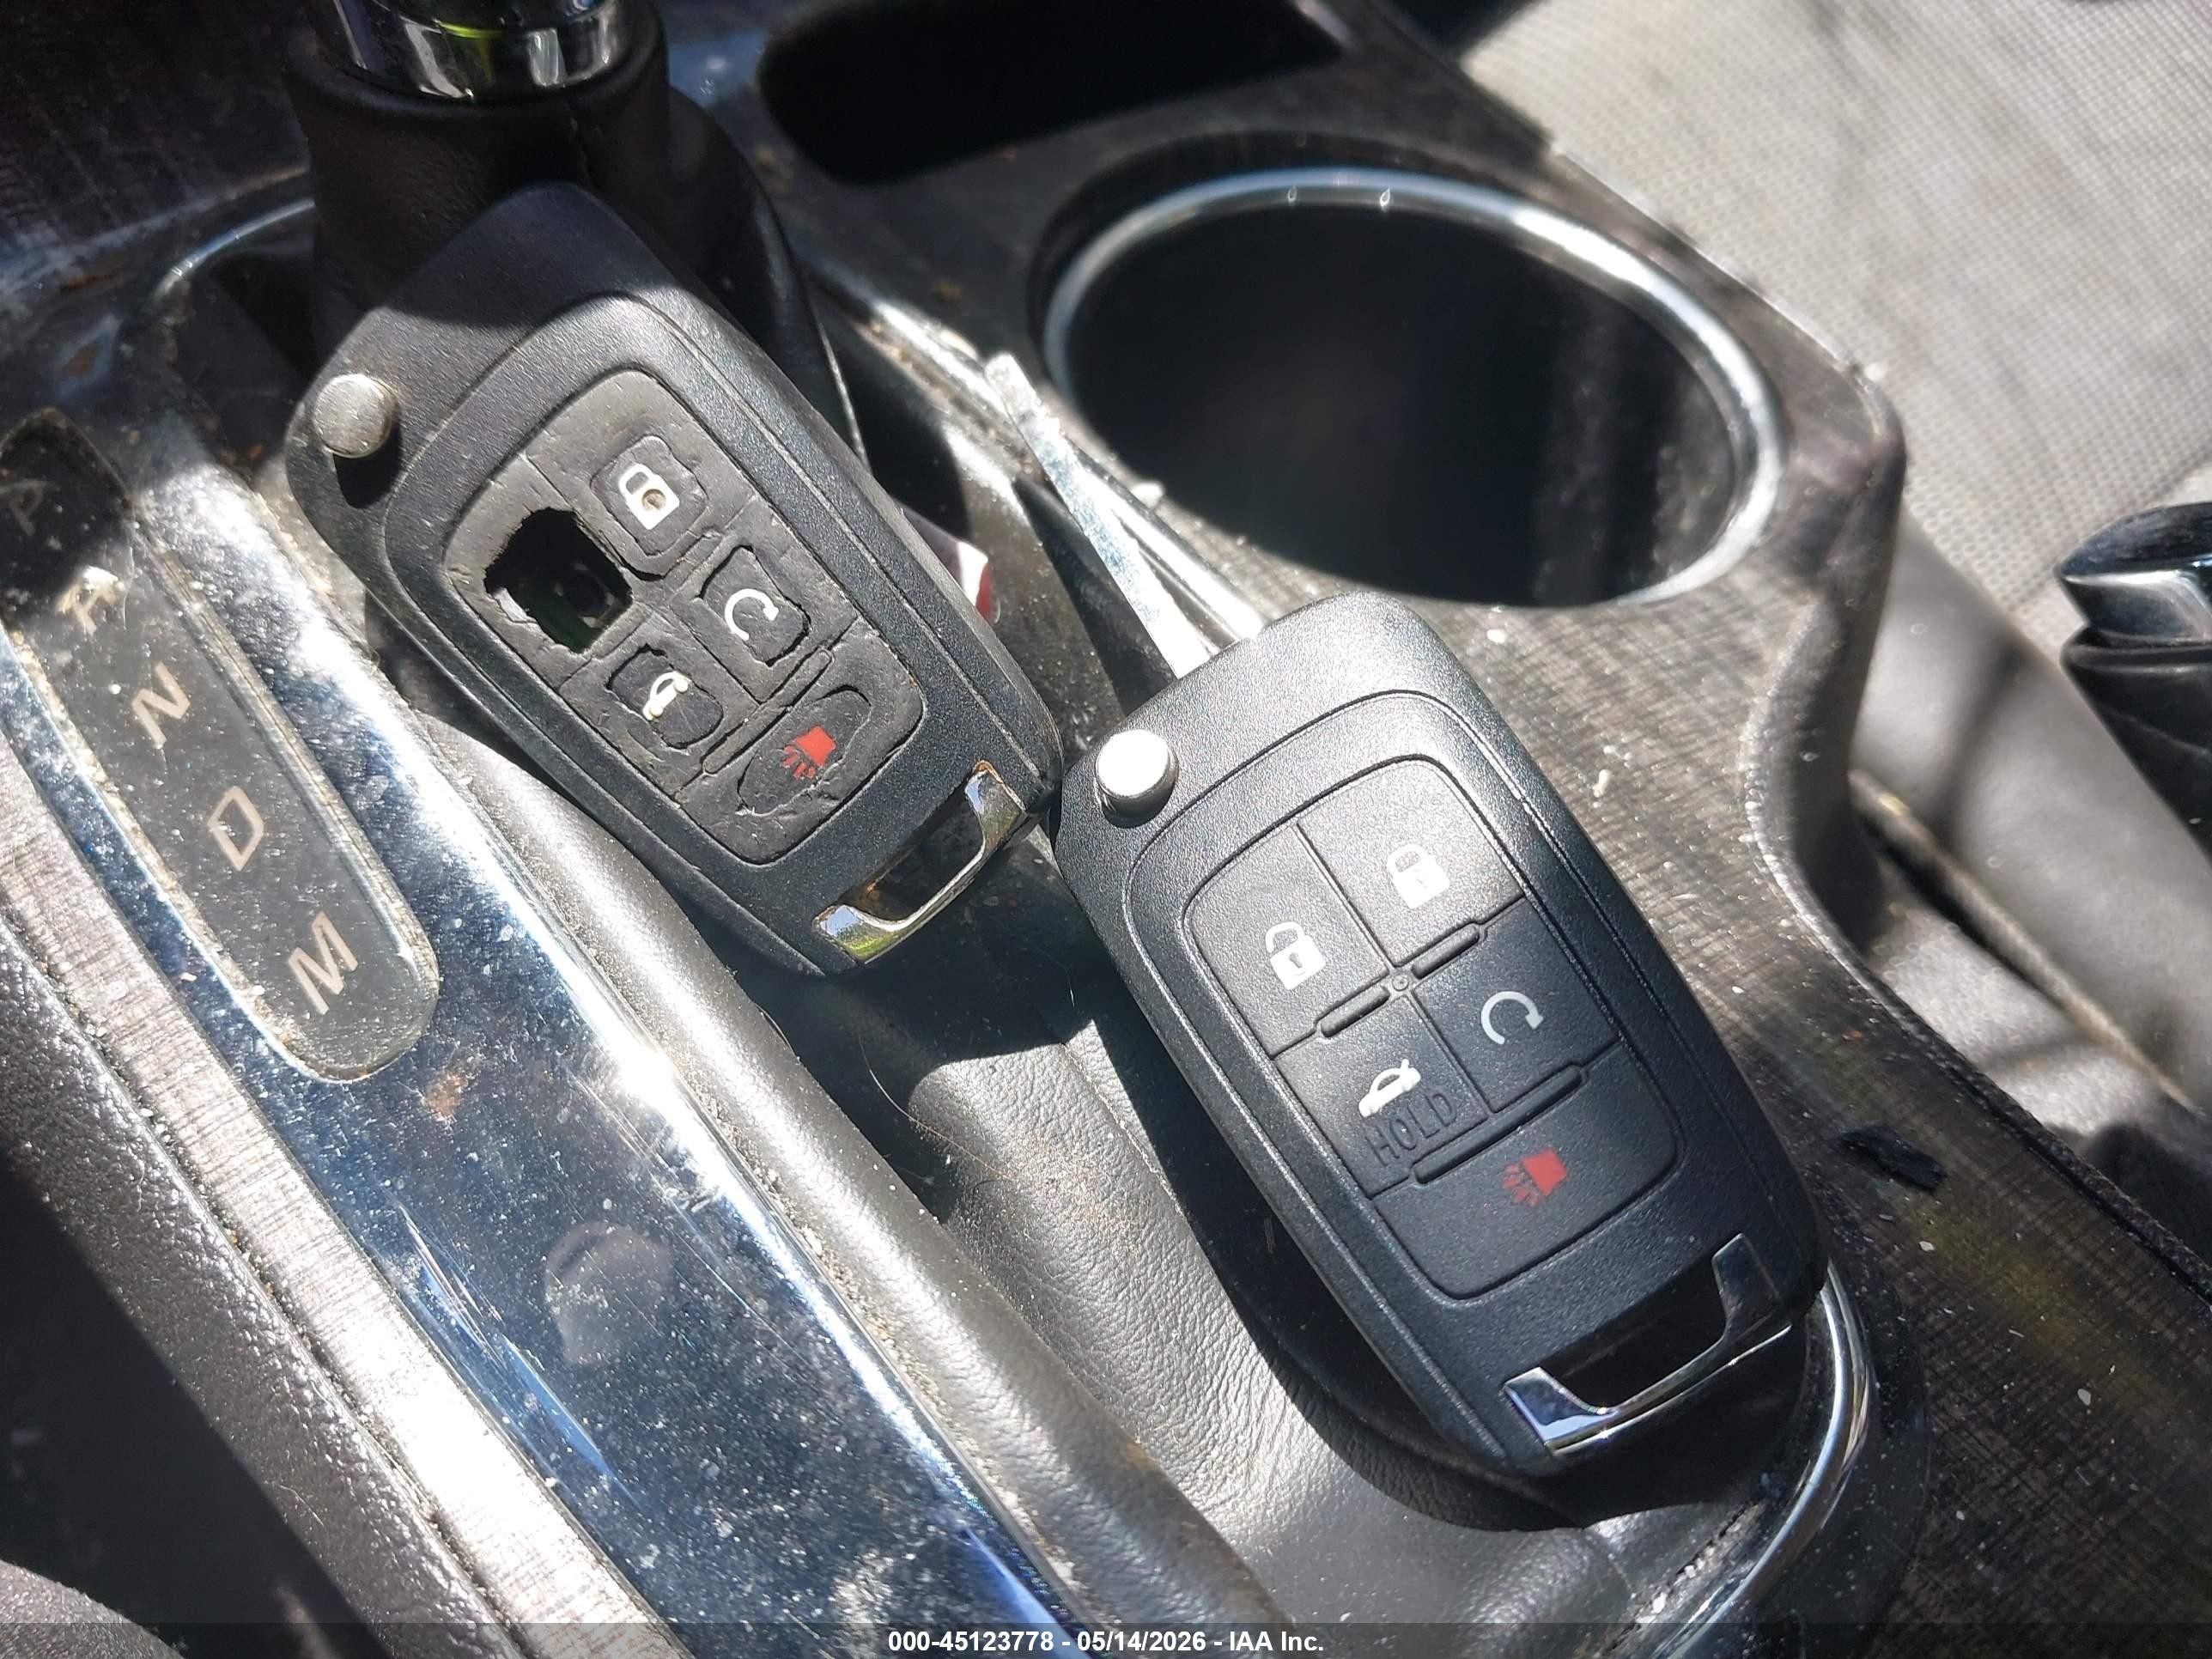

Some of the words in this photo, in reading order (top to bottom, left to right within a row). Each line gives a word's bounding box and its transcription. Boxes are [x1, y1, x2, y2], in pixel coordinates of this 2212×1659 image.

[131, 661, 191, 750] N
[206, 786, 264, 872] D
[287, 911, 359, 1014] M
[1360, 1091, 1458, 1167] HOLD
